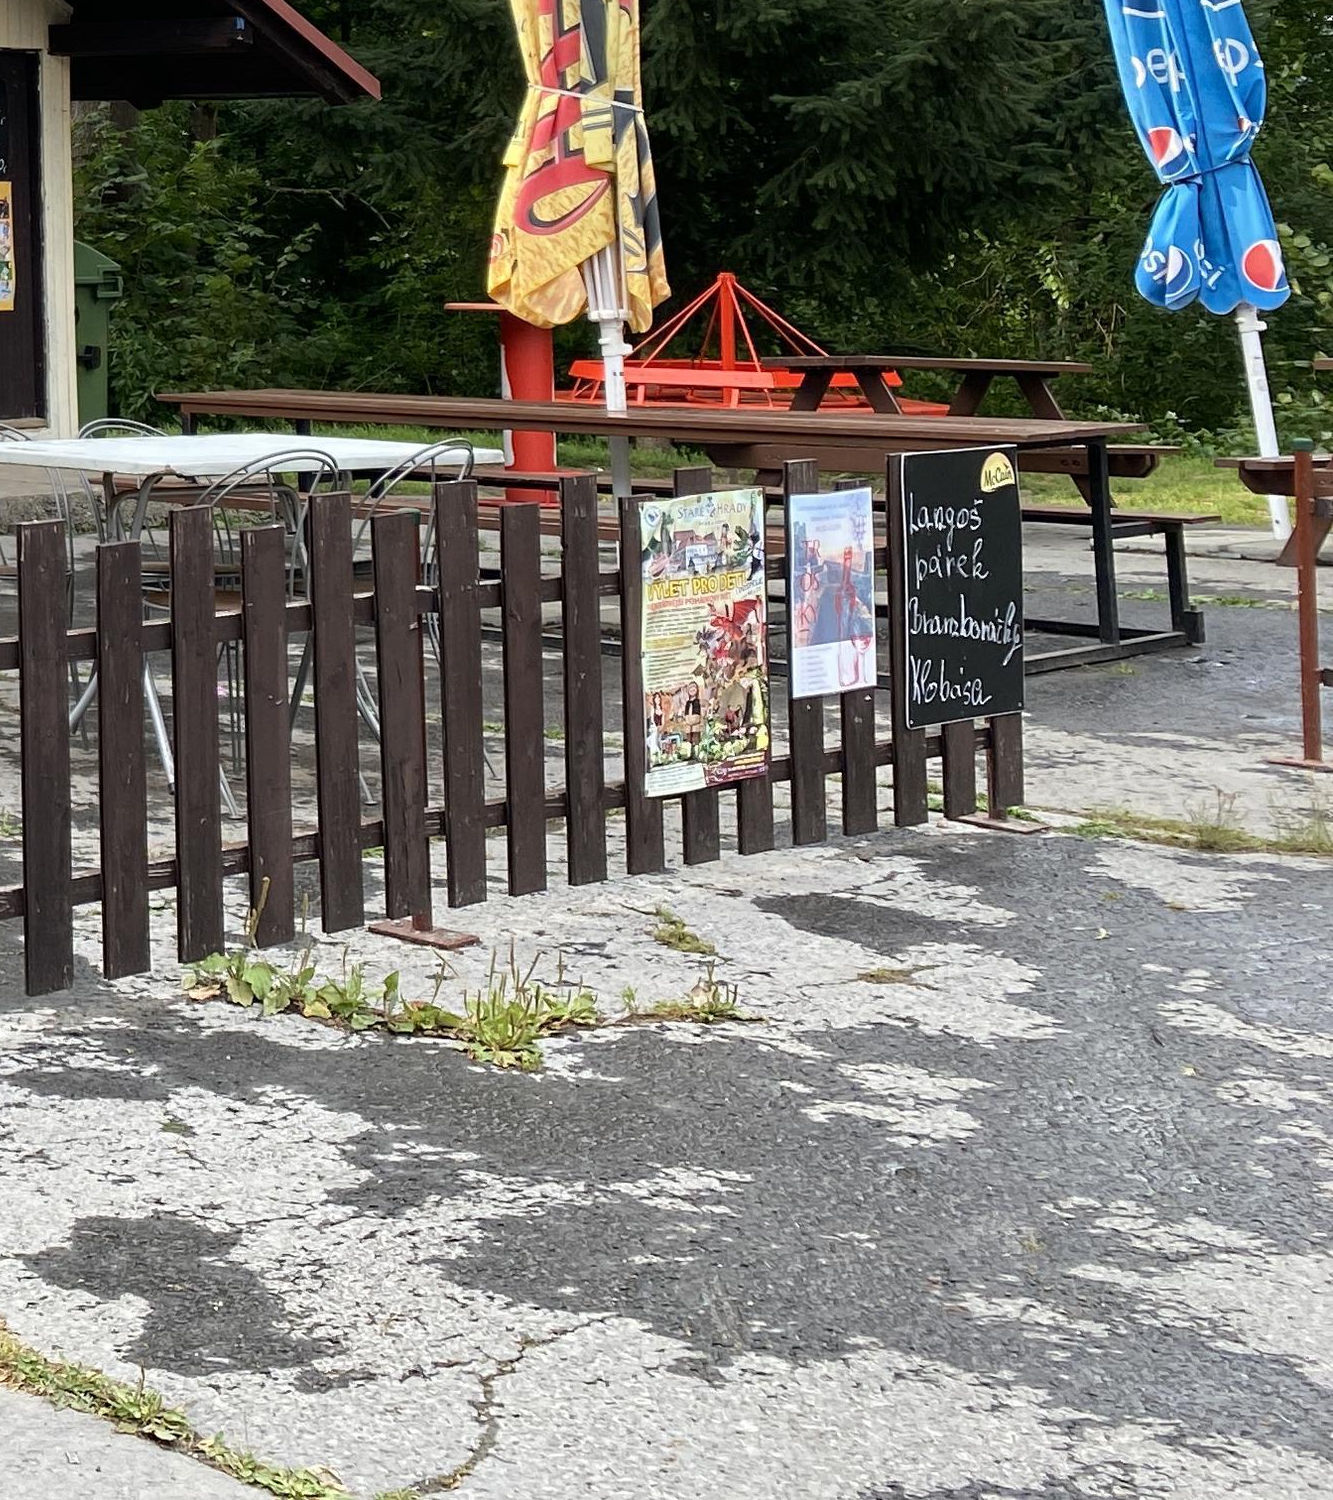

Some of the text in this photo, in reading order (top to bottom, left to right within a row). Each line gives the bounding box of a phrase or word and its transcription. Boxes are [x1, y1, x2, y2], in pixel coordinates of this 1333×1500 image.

[984, 462, 1013, 486] McCain
[909, 492, 983, 552] Langoš
[693, 575, 718, 595] PRO
[916, 538, 990, 590] párek
[910, 655, 992, 705] Klobása
